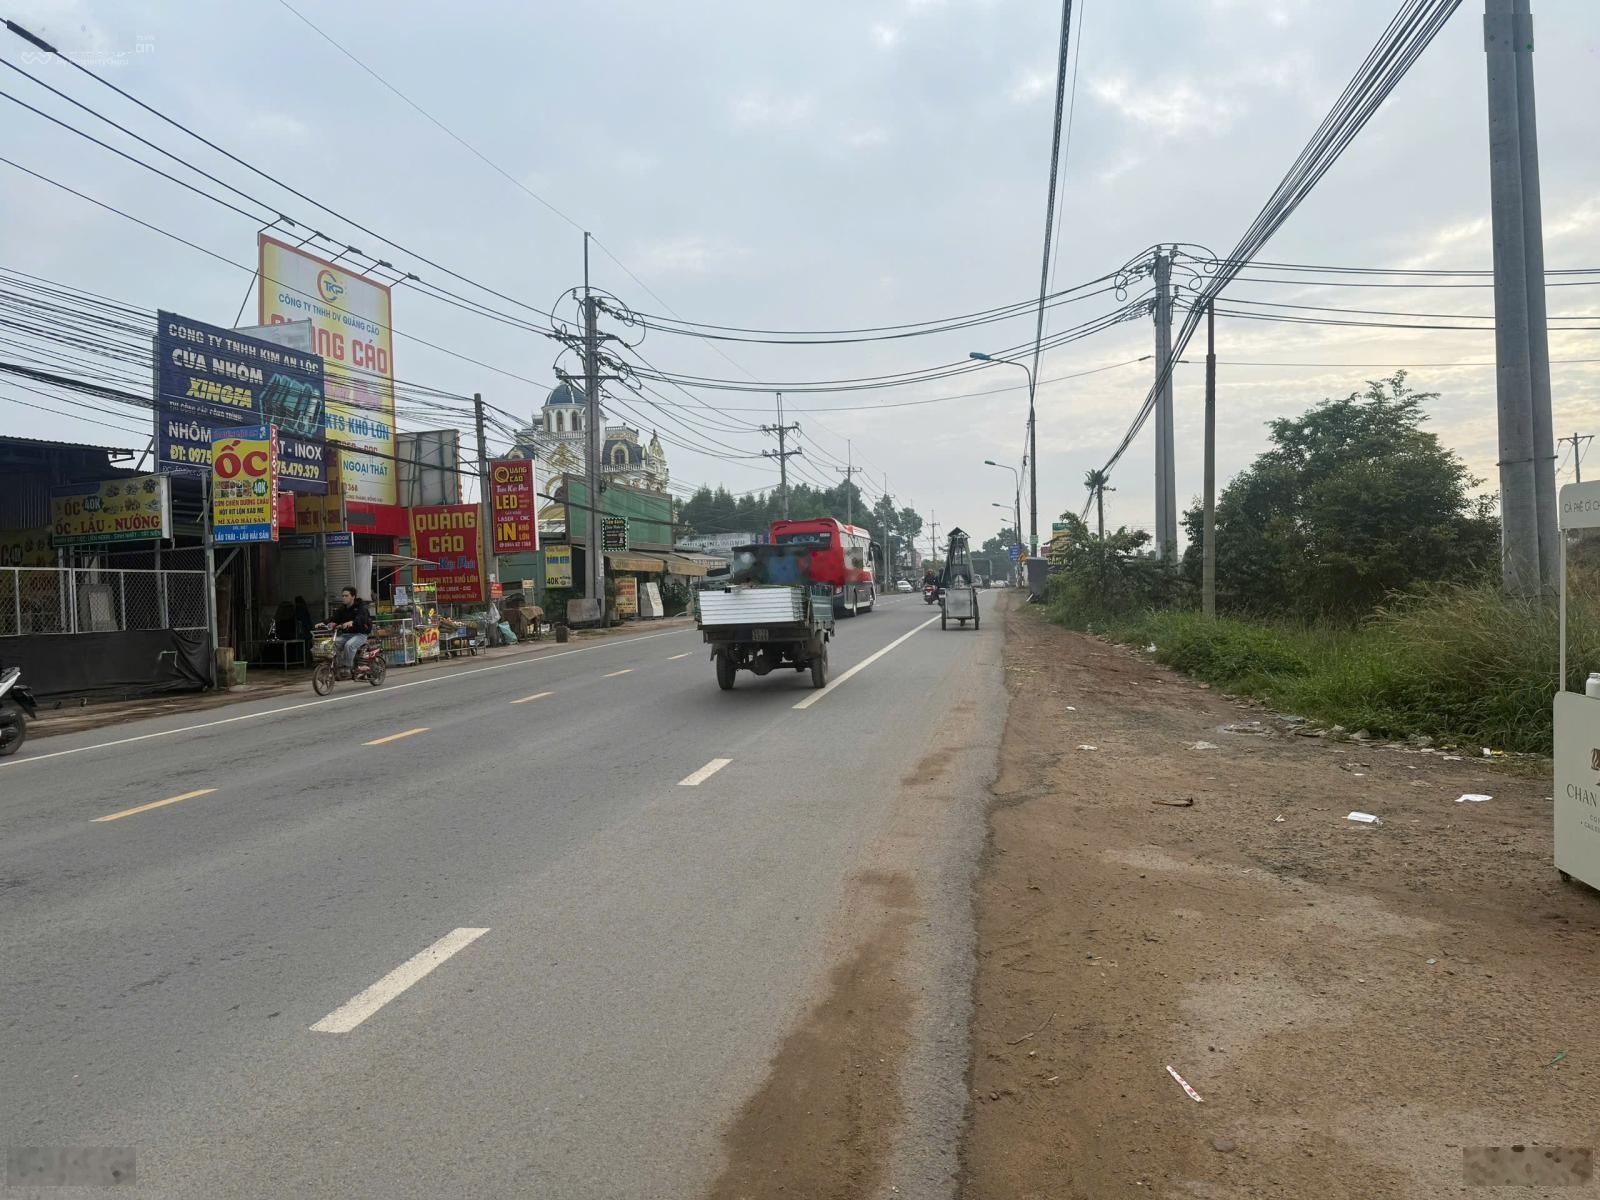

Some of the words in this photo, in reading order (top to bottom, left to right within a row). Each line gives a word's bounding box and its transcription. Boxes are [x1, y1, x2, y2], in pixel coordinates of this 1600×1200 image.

[278, 294, 302, 308] CÔNG
[304, 302, 311, 312] TY
[312, 305, 330, 320] TNHH
[208, 334, 222, 348] TY
[226, 339, 256, 356] TNHH
[260, 348, 280, 364] KIM
[284, 355, 298, 368] AN
[352, 339, 388, 374] CÁO
[172, 346, 208, 372] CỬA
[212, 358, 264, 384] NHÔM
[186, 376, 252, 408] XINGFA
[168, 420, 212, 442] NHÔM
[294, 442, 322, 460] INOX
[170, 444, 186, 460] ĐT:
[214, 440, 268, 478] ỐC
[343, 460, 368, 476] NGOẠI
[370, 462, 388, 476] THẤT
[64, 498, 80, 516] ỐC
[84, 498, 100, 510] 40K
[496, 494, 518, 510] LED
[56, 518, 71, 535] ỐC
[80, 513, 104, 533] LẨU
[114, 513, 160, 530] NƯỚNG
[416, 508, 476, 532] QUẢNG
[429, 533, 464, 552] CÁO
[1567, 784, 1596, 807] CHAN
